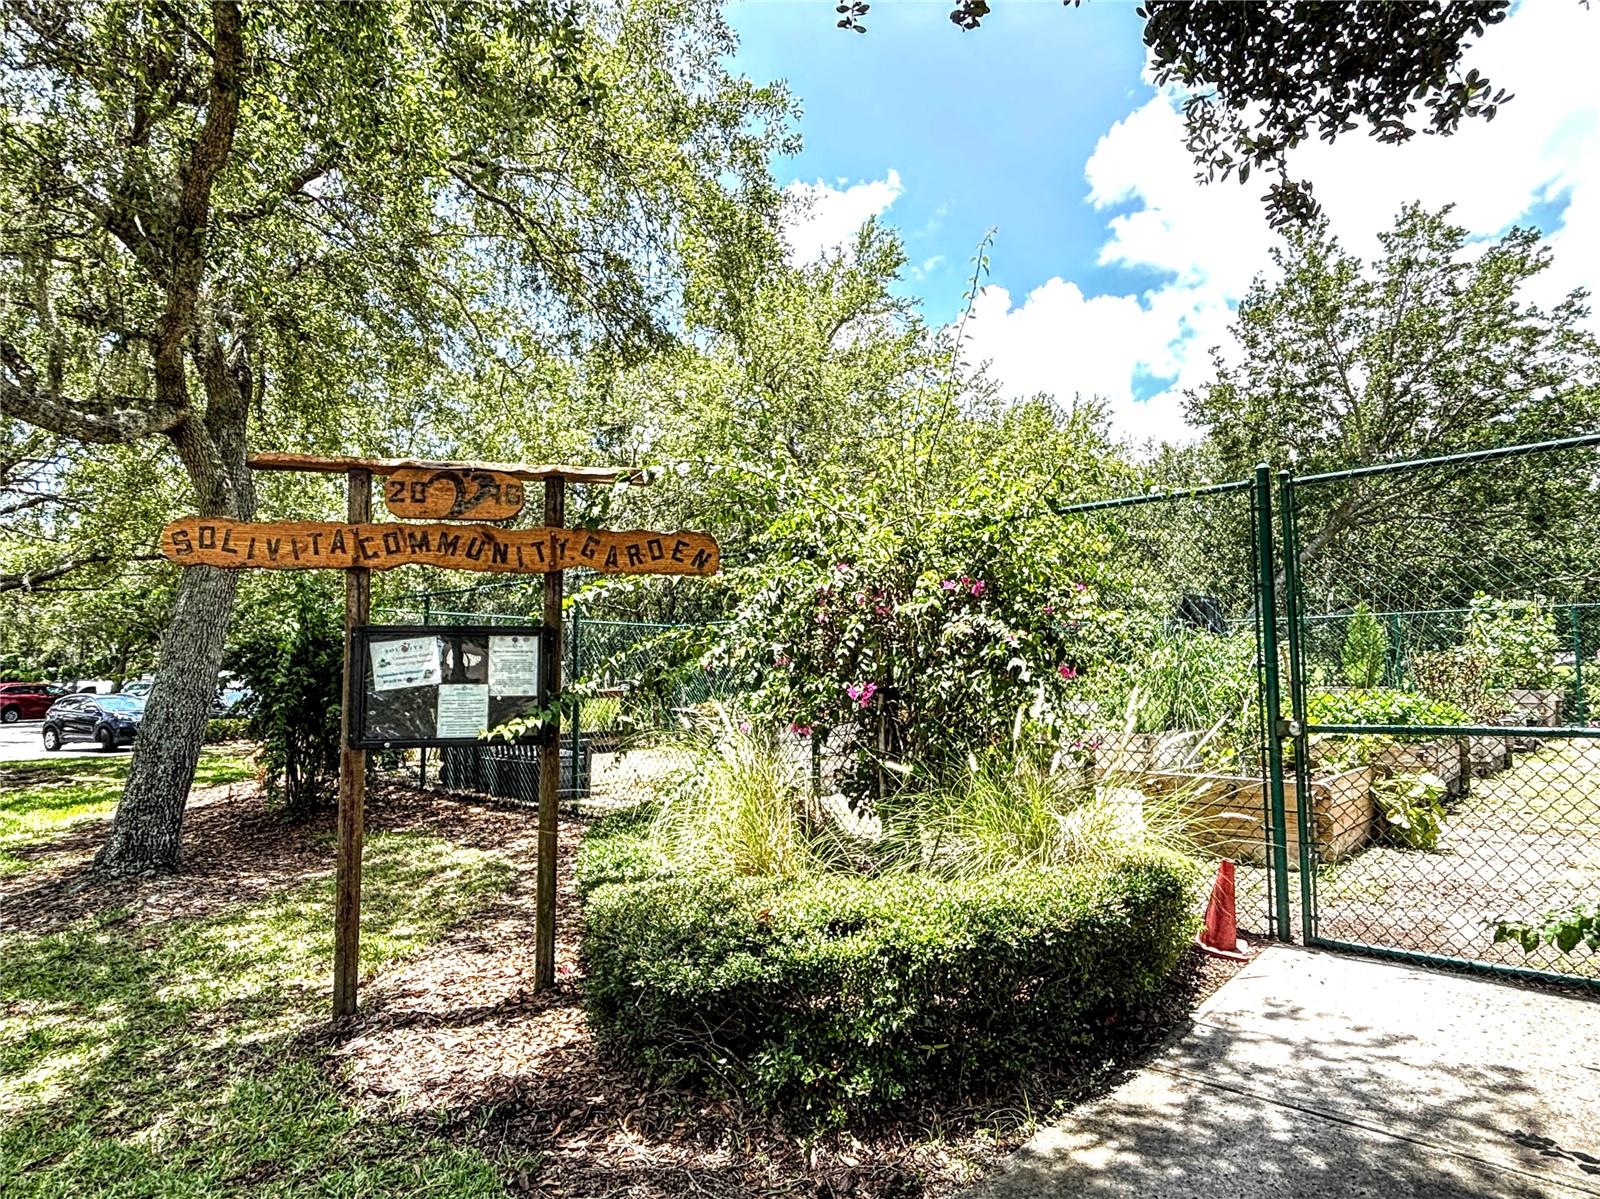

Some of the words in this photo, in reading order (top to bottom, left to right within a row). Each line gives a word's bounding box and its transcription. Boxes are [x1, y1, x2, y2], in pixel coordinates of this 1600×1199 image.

[388, 480, 426, 503] 20
[171, 525, 347, 562] SOLIVITA
[357, 528, 570, 568] COMMUNITY
[580, 535, 712, 570] GARDEN
